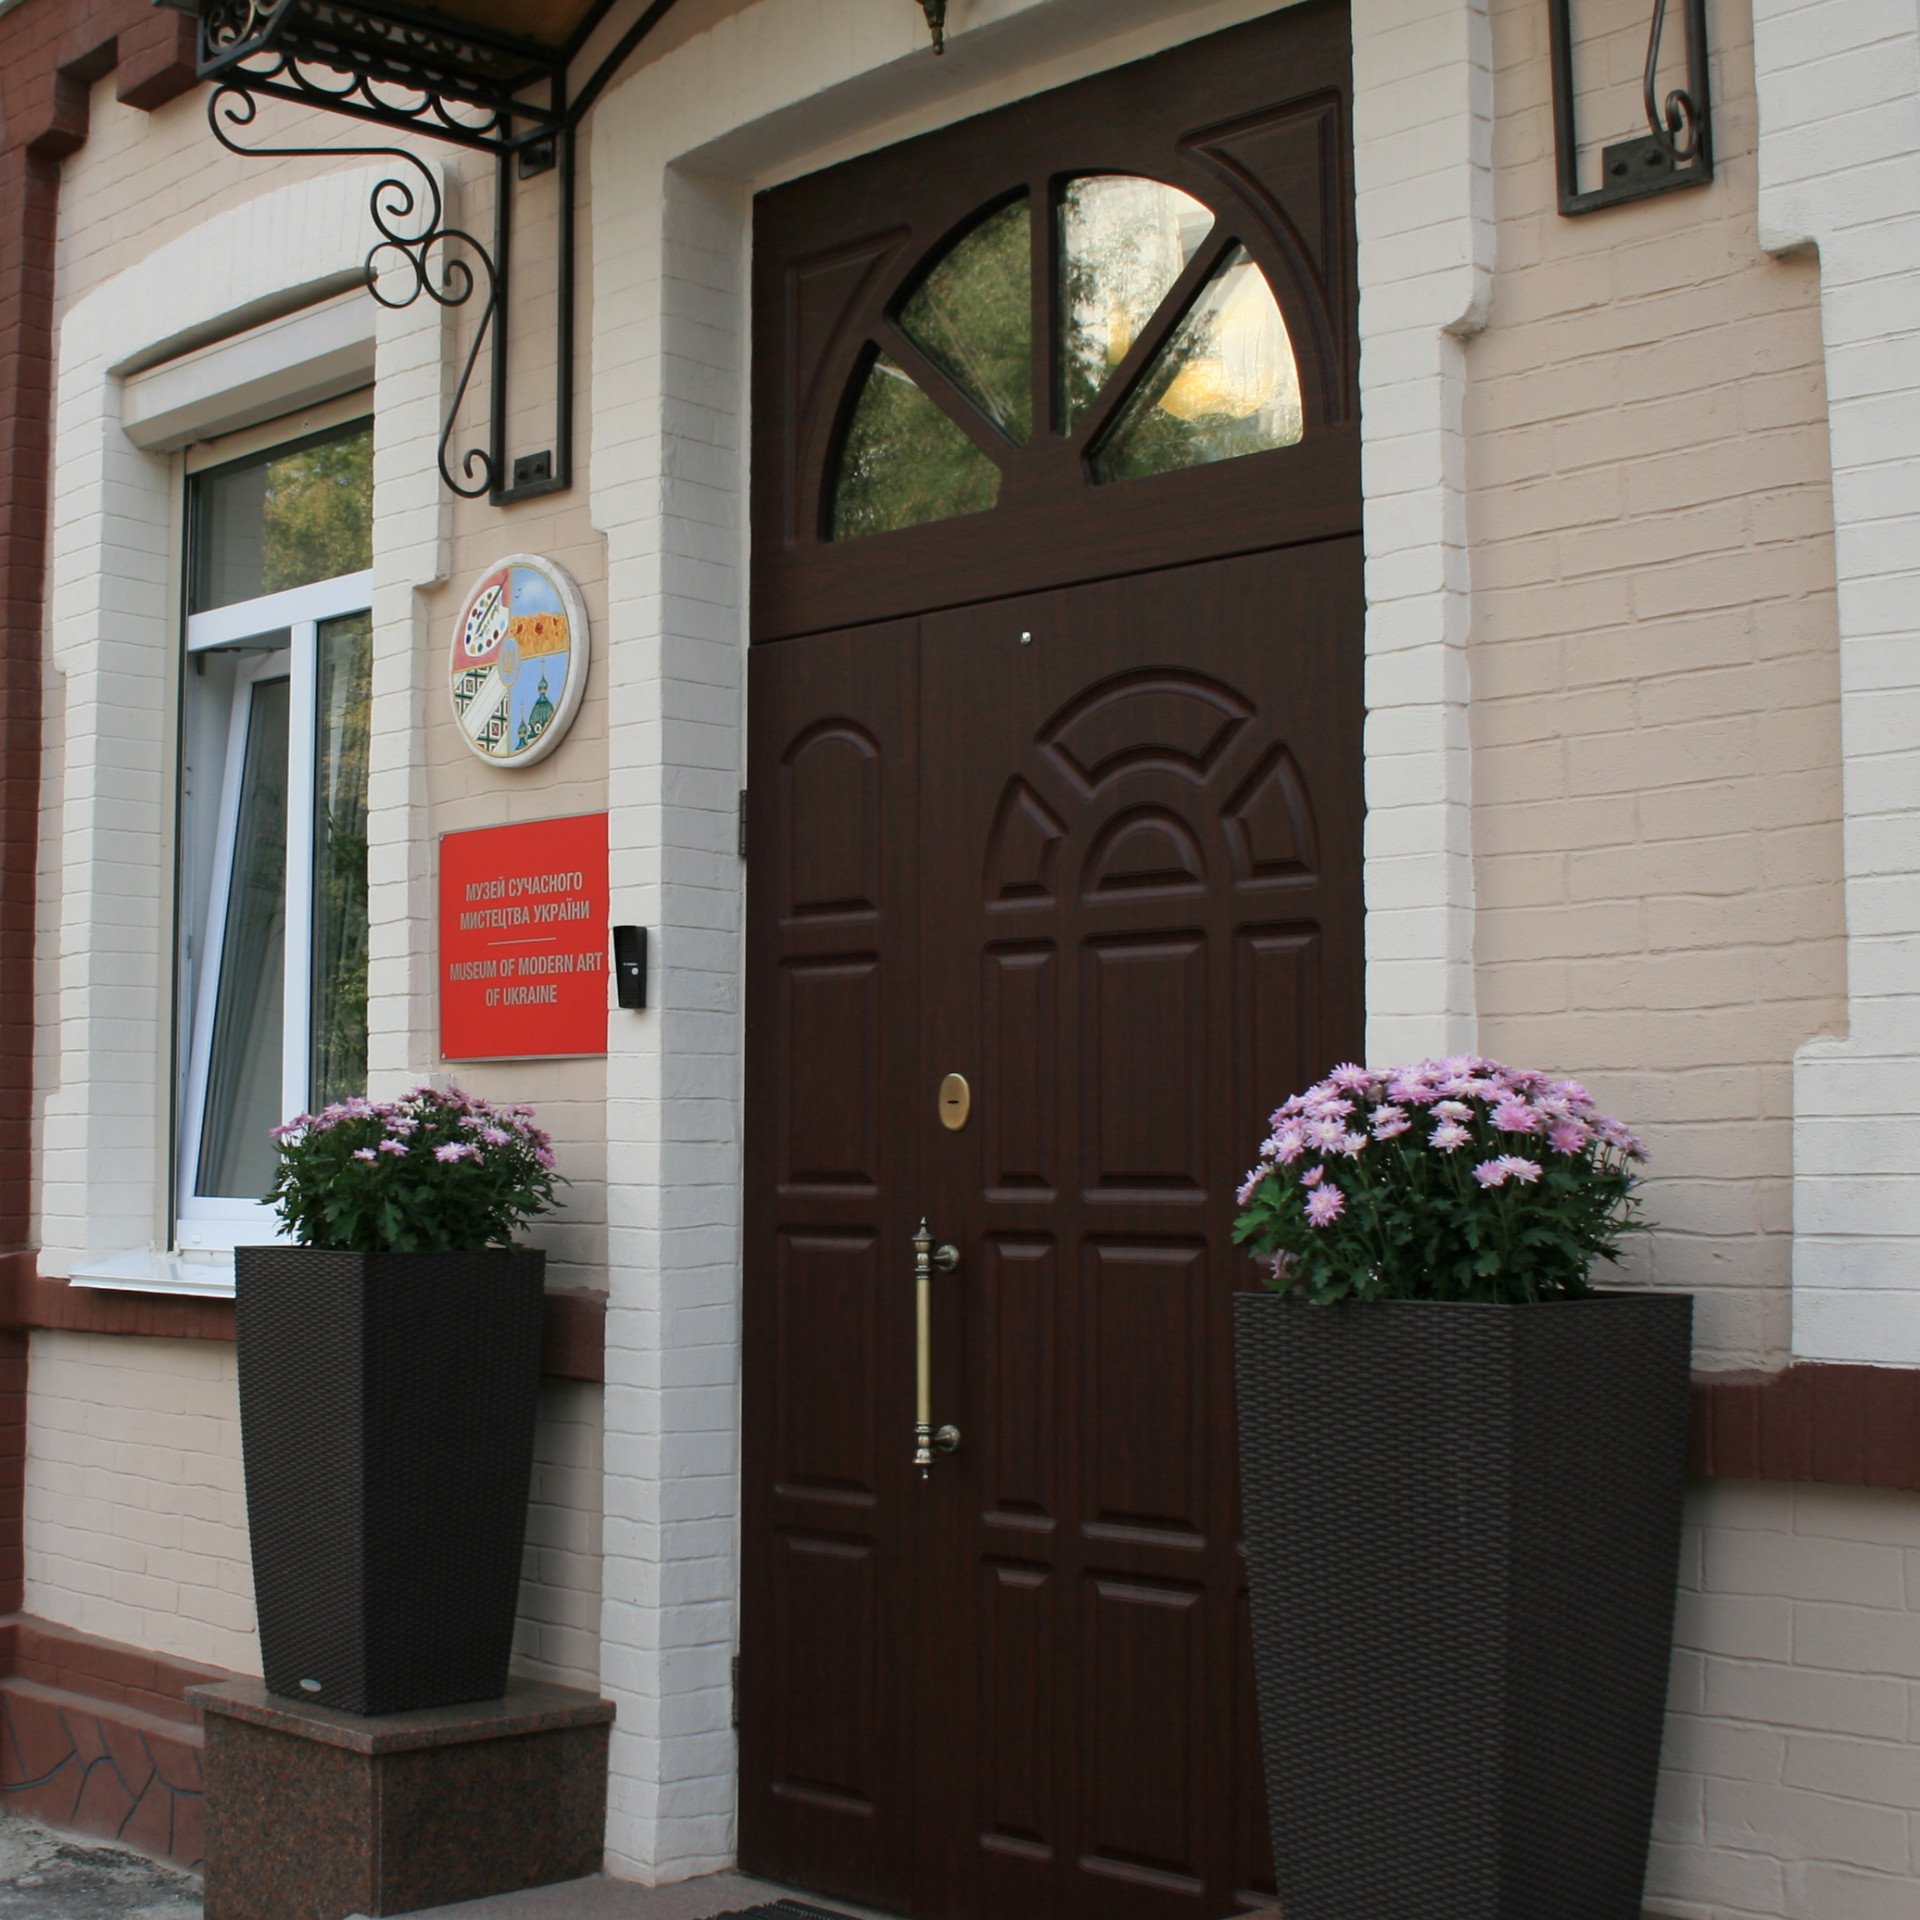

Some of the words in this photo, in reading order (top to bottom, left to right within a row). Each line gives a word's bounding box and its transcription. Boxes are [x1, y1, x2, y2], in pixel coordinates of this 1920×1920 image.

[466, 877, 505, 902] МУЗЕЙ
[508, 871, 583, 897] СУЧАСНОГО
[460, 906, 530, 930] МИСТЕЦТВА
[533, 898, 590, 923] УКРАЇНИ
[450, 960, 497, 980] MUSEUM
[500, 959, 515, 977] OF
[518, 954, 573, 976] MODERN
[576, 952, 603, 972] ART
[486, 988, 500, 1007] OF
[503, 984, 557, 1006] UKRAINE
